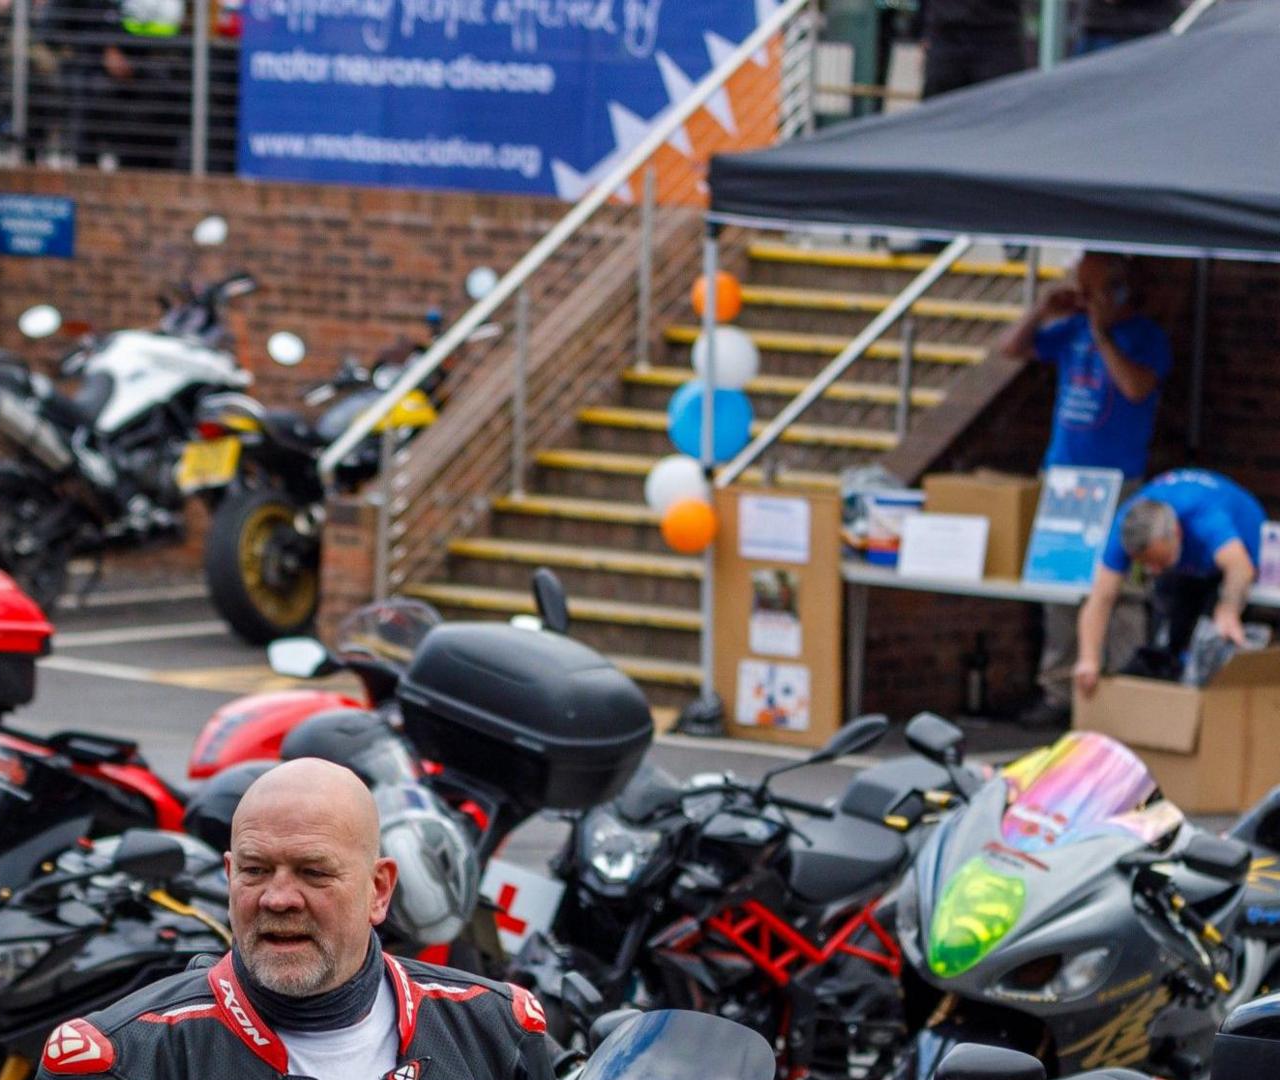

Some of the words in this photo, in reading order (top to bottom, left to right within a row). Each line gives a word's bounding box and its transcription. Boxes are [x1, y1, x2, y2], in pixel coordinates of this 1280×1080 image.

[250, 49, 330, 83] motor
[333, 54, 447, 89] neurone
[447, 53, 556, 95] disease
[219, 977, 271, 1047] IXON
